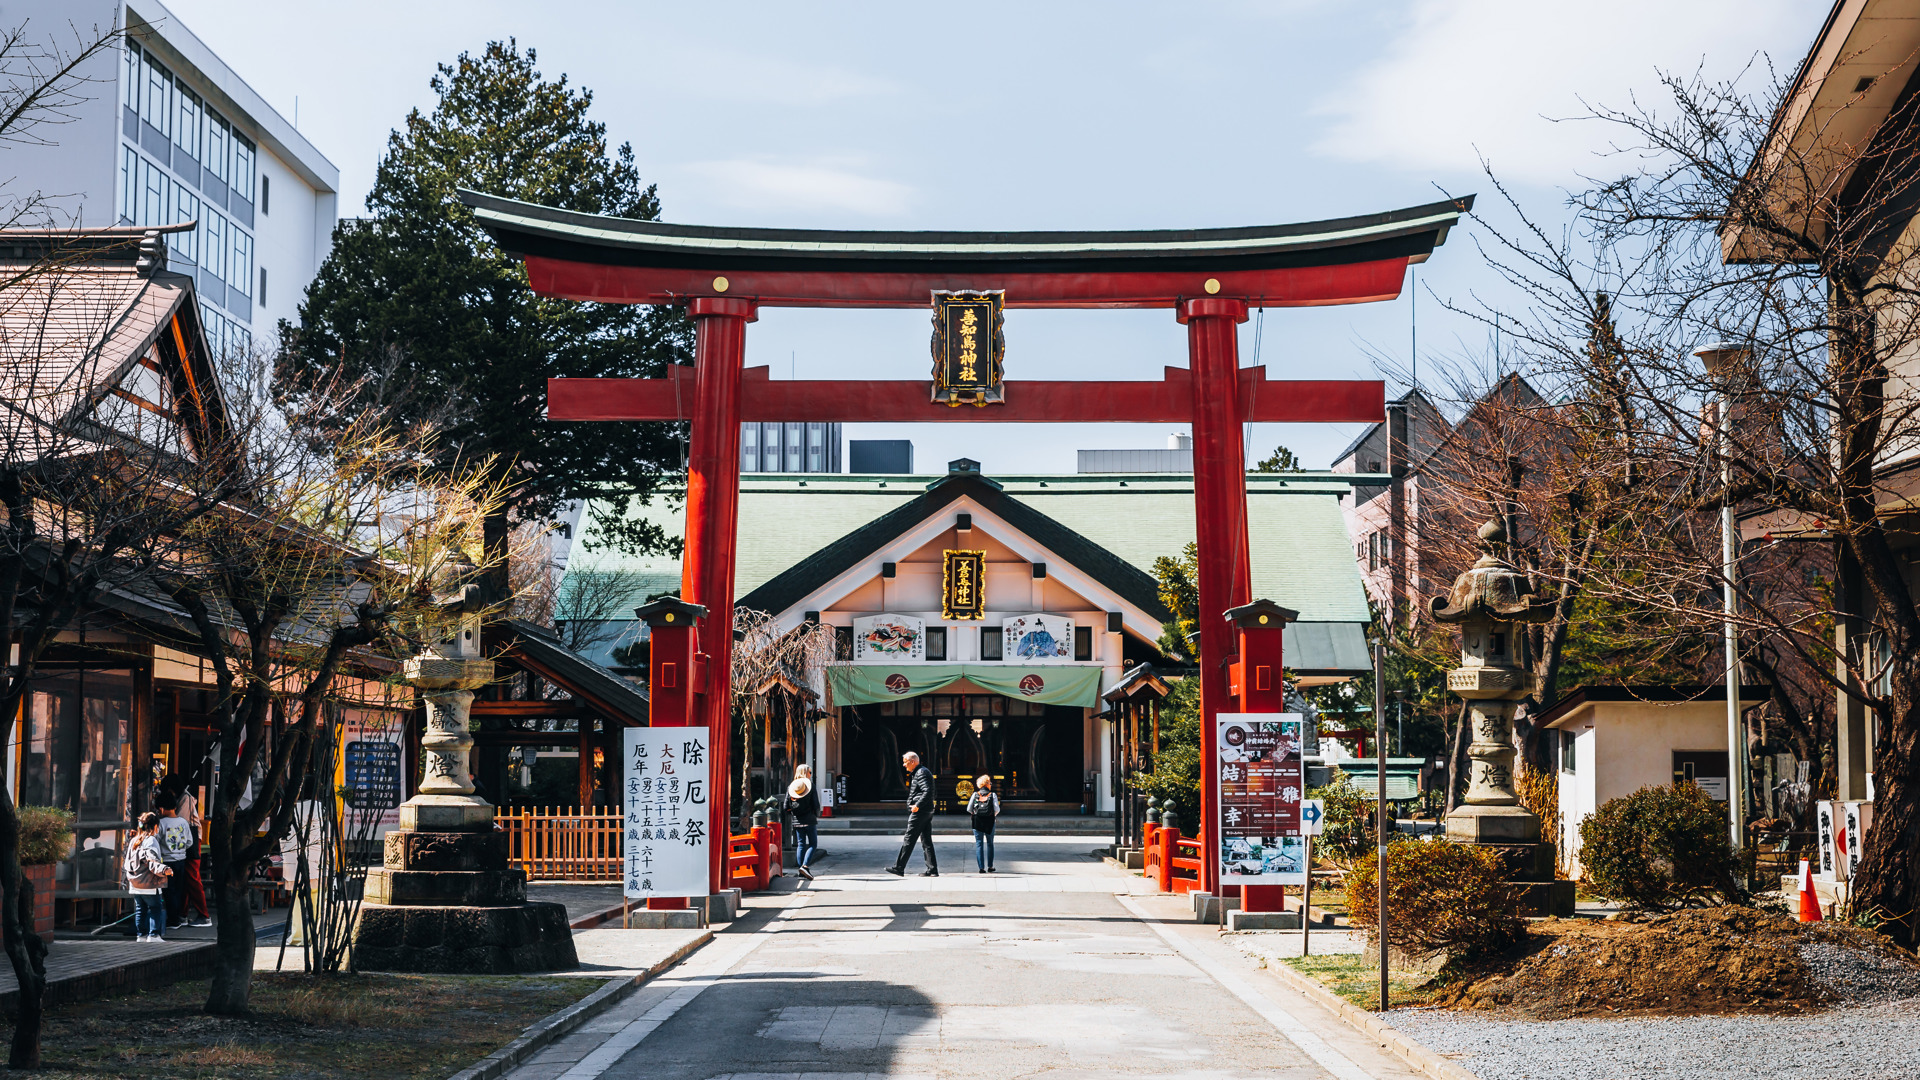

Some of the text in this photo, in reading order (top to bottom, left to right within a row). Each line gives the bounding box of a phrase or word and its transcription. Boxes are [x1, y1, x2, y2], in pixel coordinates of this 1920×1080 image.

[959, 308, 978, 382] 善知鳥神社
[632, 743, 649, 776] 厄年
[659, 743, 676, 775] 大厄
[1222, 763, 1240, 781] 結
[682, 738, 706, 847] 除厄祭
[1282, 785, 1301, 804] 雅
[1224, 807, 1242, 827] 幸
[627, 845, 640, 891] 三十七歳
[641, 845, 654, 891] 六十一歳
